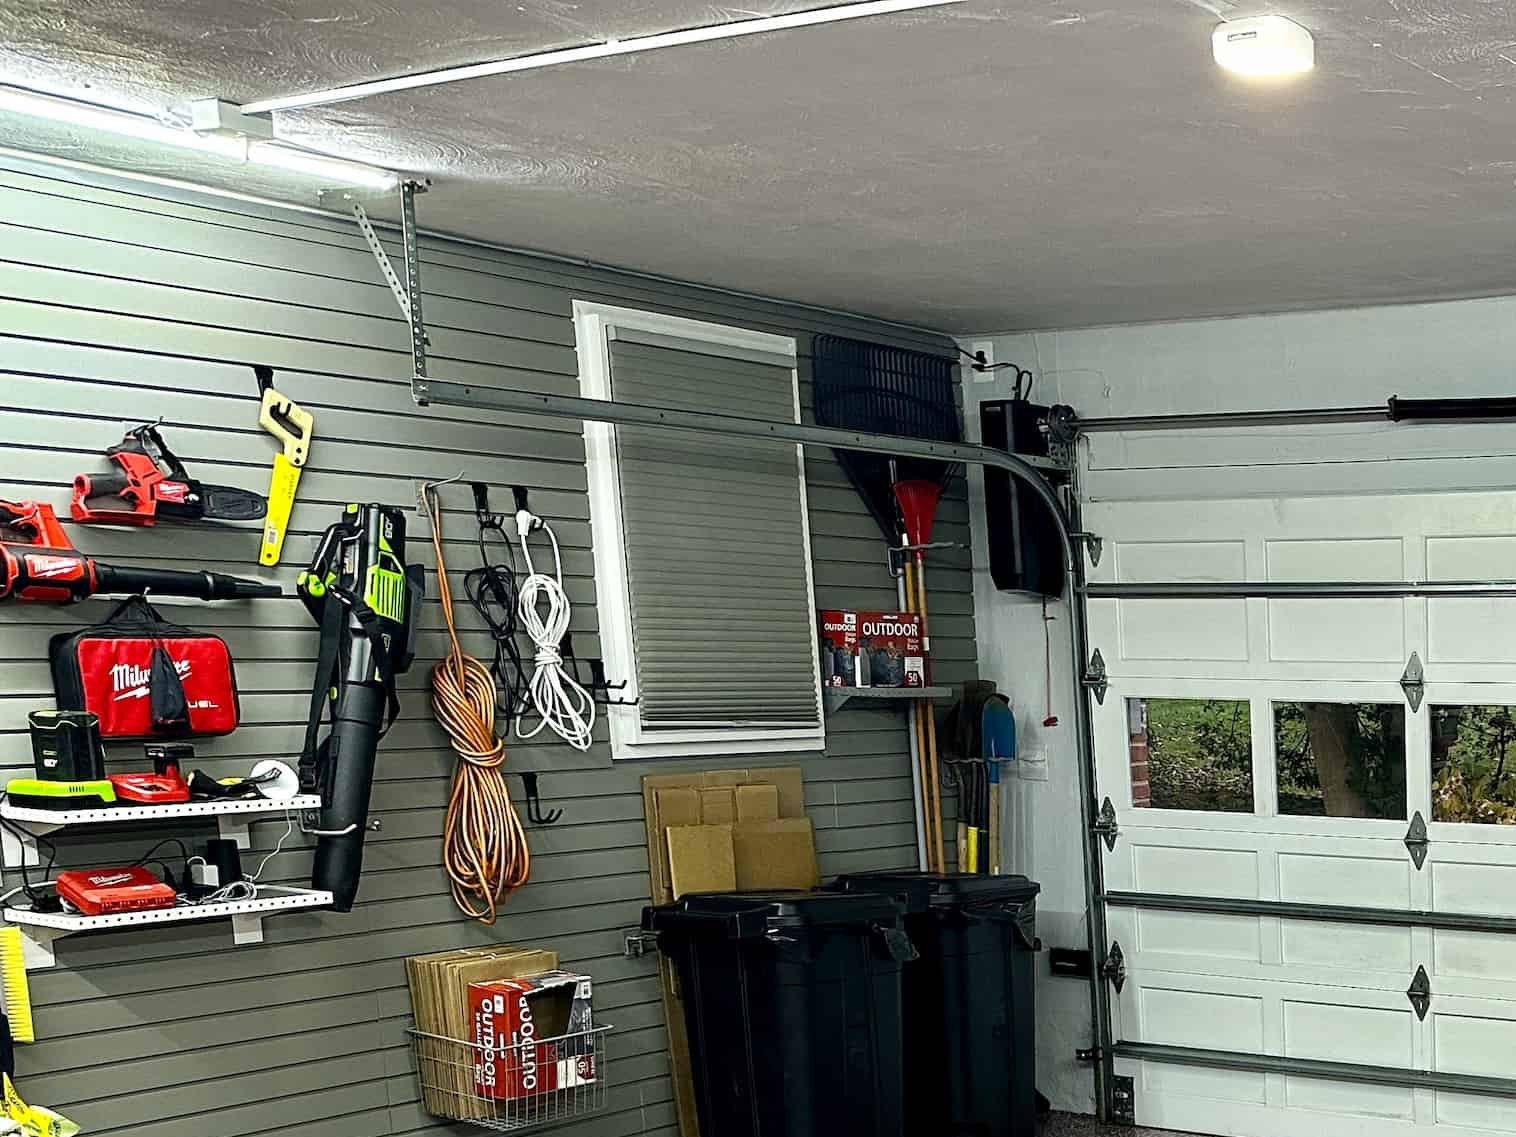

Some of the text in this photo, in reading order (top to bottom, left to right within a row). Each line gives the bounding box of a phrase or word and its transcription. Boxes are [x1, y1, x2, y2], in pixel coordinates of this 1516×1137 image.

[862, 622, 918, 637] OUTDOOR
[908, 672, 918, 682] 50
[187, 700, 219, 709] UEL
[481, 999, 496, 1087] OUTDOOR
